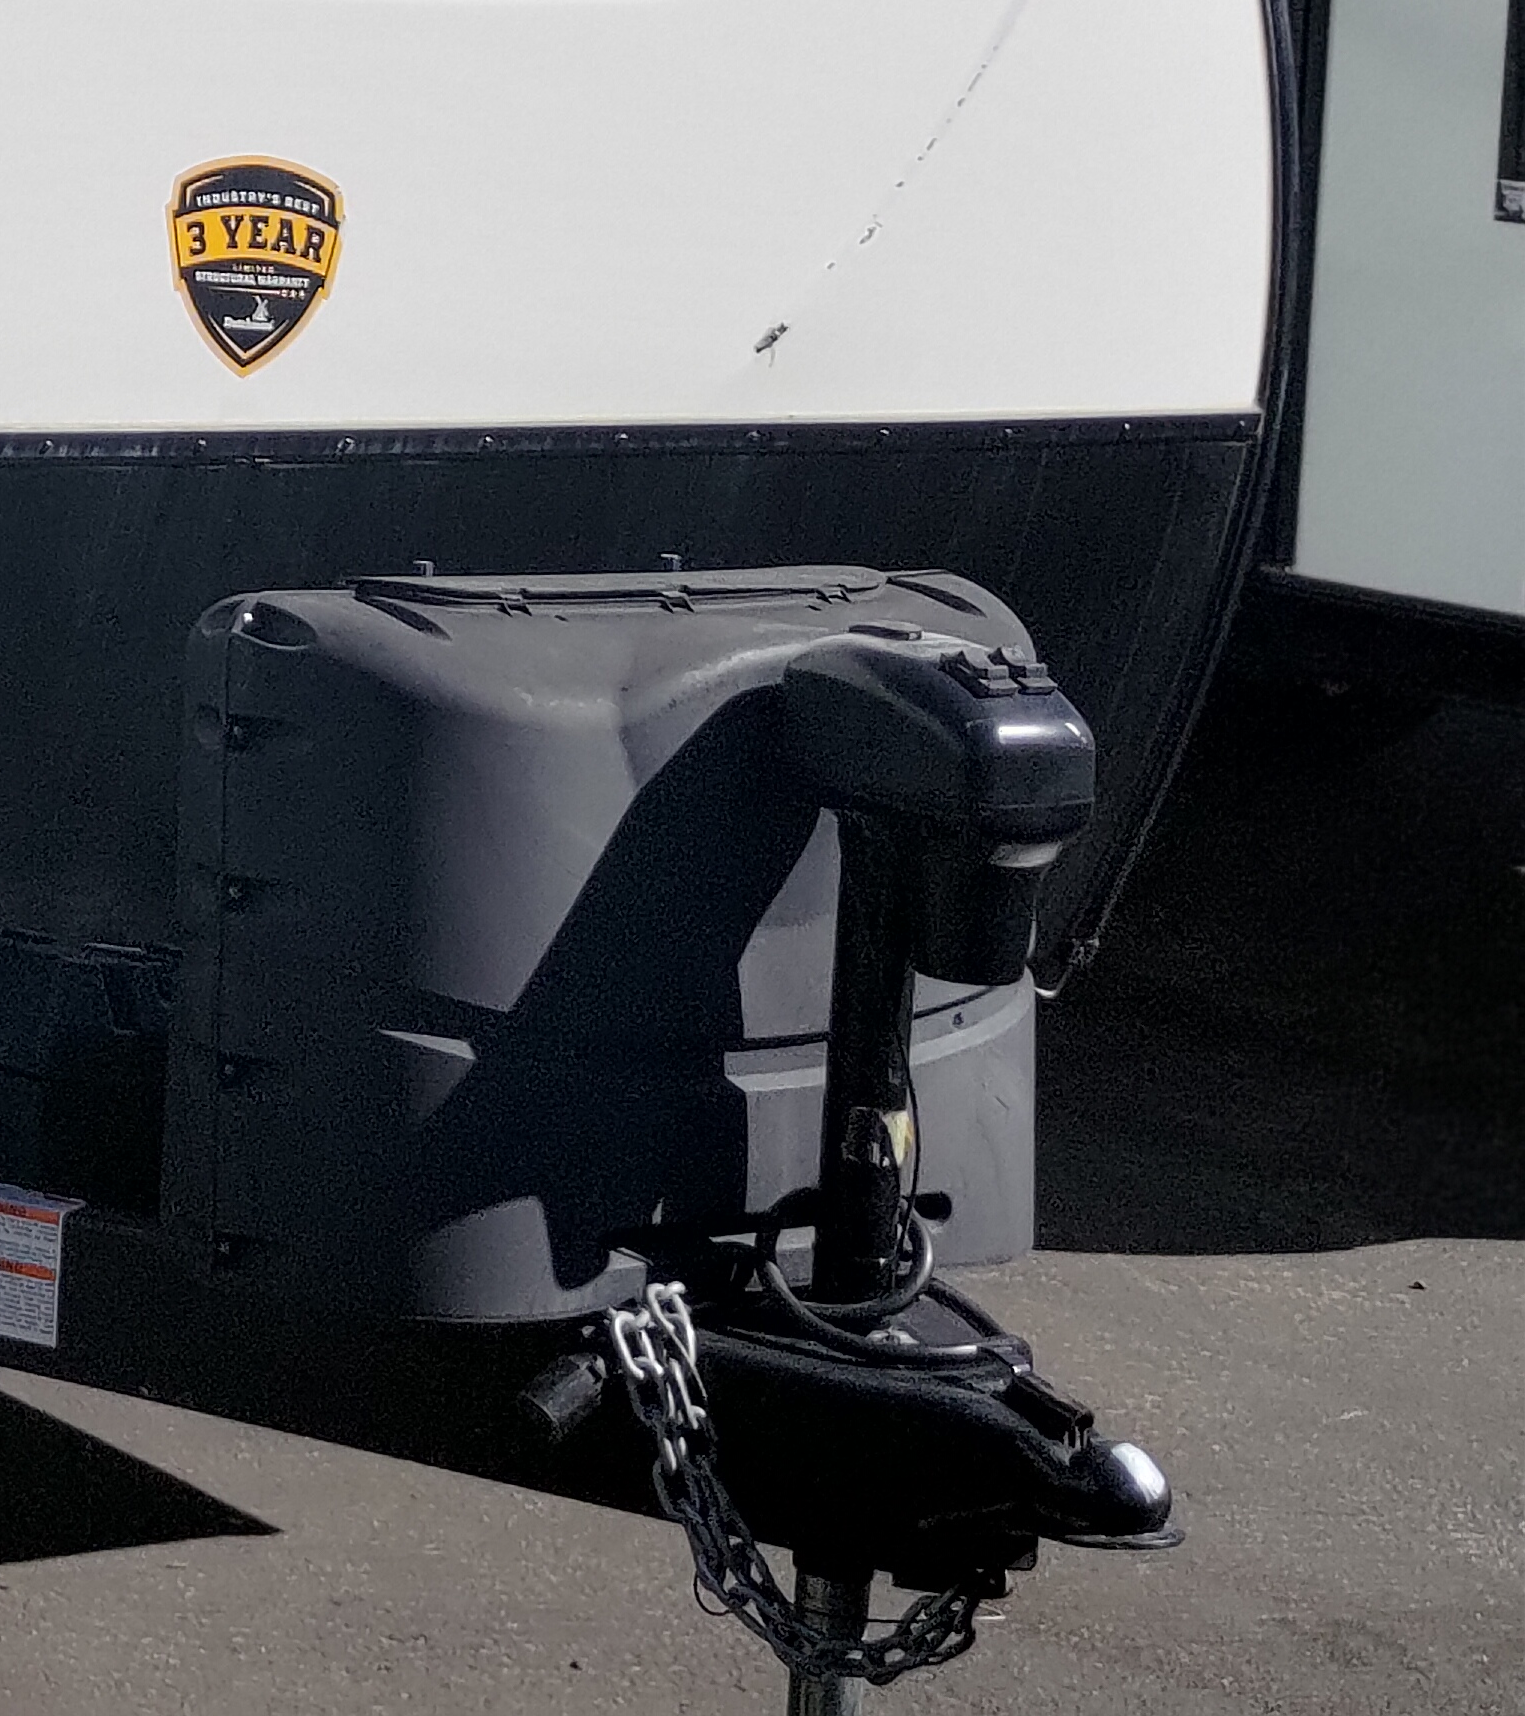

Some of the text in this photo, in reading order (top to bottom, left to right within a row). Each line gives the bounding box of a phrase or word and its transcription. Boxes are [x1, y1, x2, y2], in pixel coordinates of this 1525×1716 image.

[195, 189, 320, 214] INDUSTRY'S BEST
[186, 214, 327, 264] 3 YEAR
